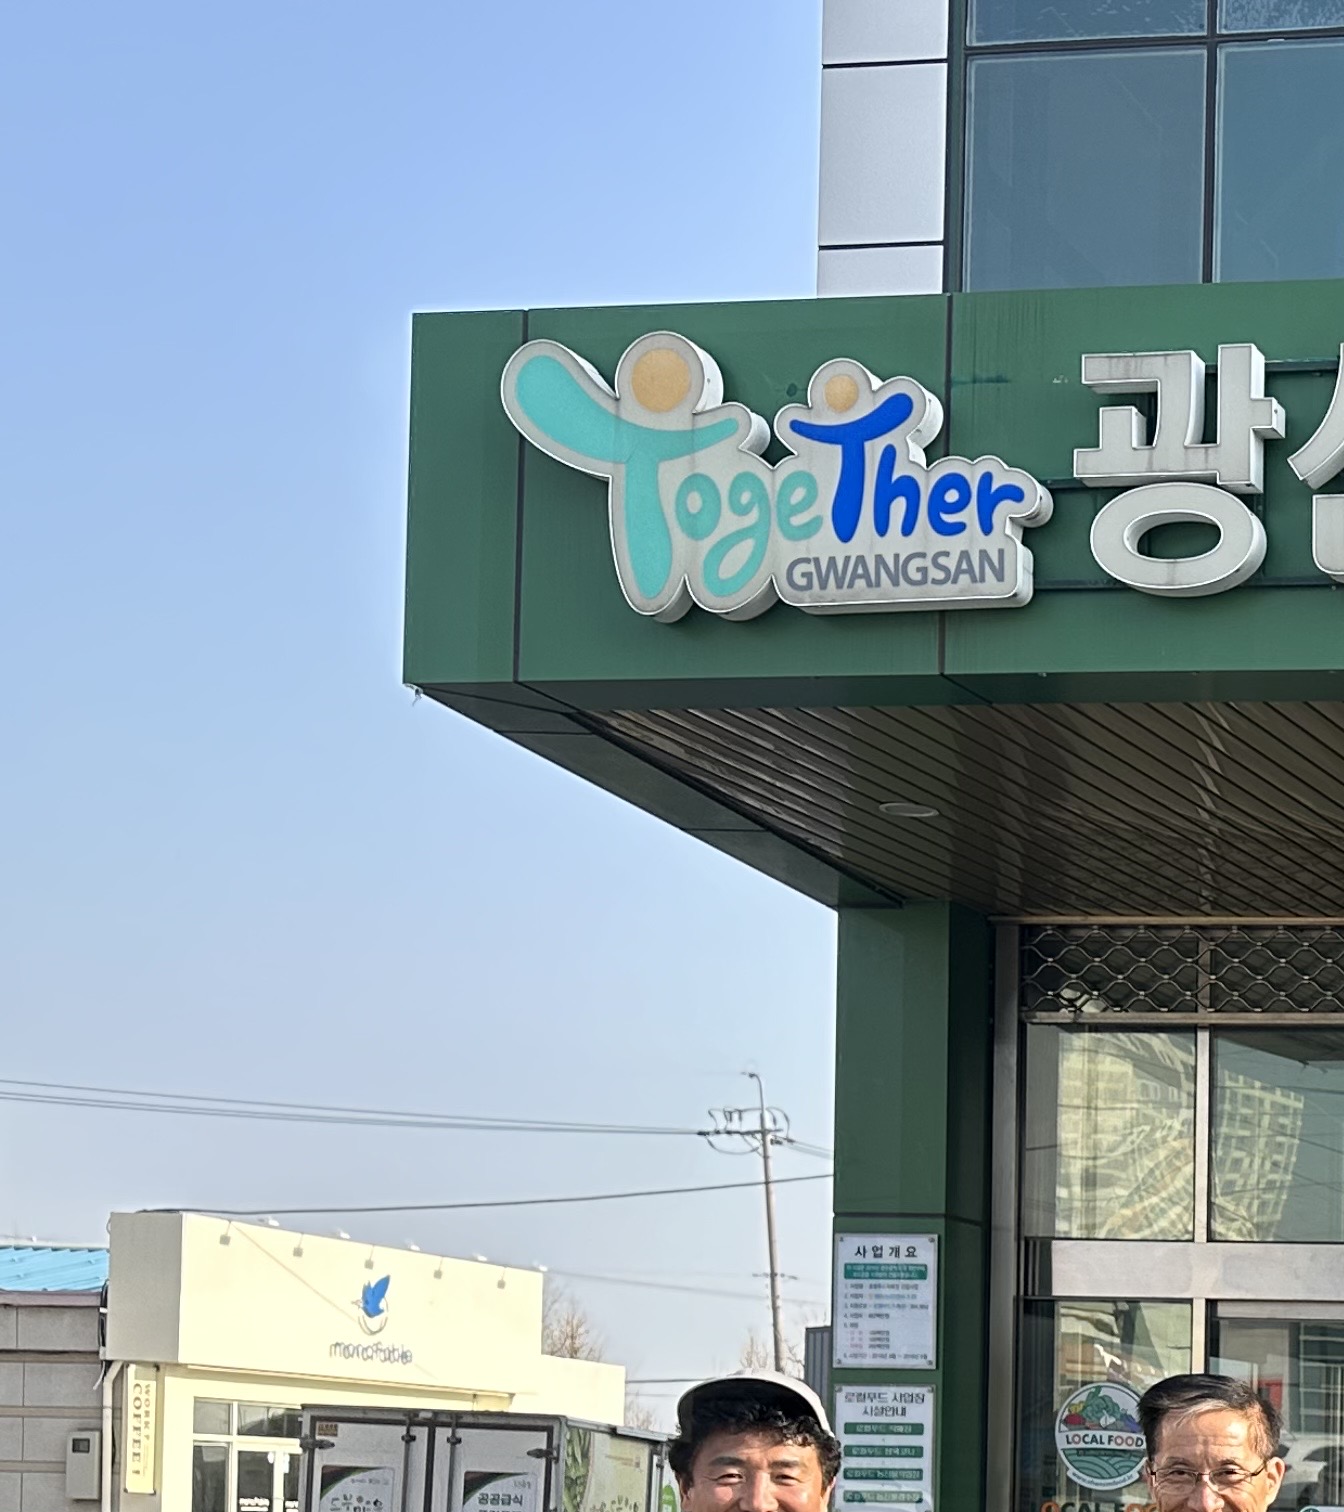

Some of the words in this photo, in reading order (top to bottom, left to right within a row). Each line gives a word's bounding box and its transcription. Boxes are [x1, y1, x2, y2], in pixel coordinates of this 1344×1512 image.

[784, 548, 1007, 596] GWANGSAN
[1065, 1433, 1106, 1446] LOCAL
[1107, 1434, 1144, 1448] FOOD
